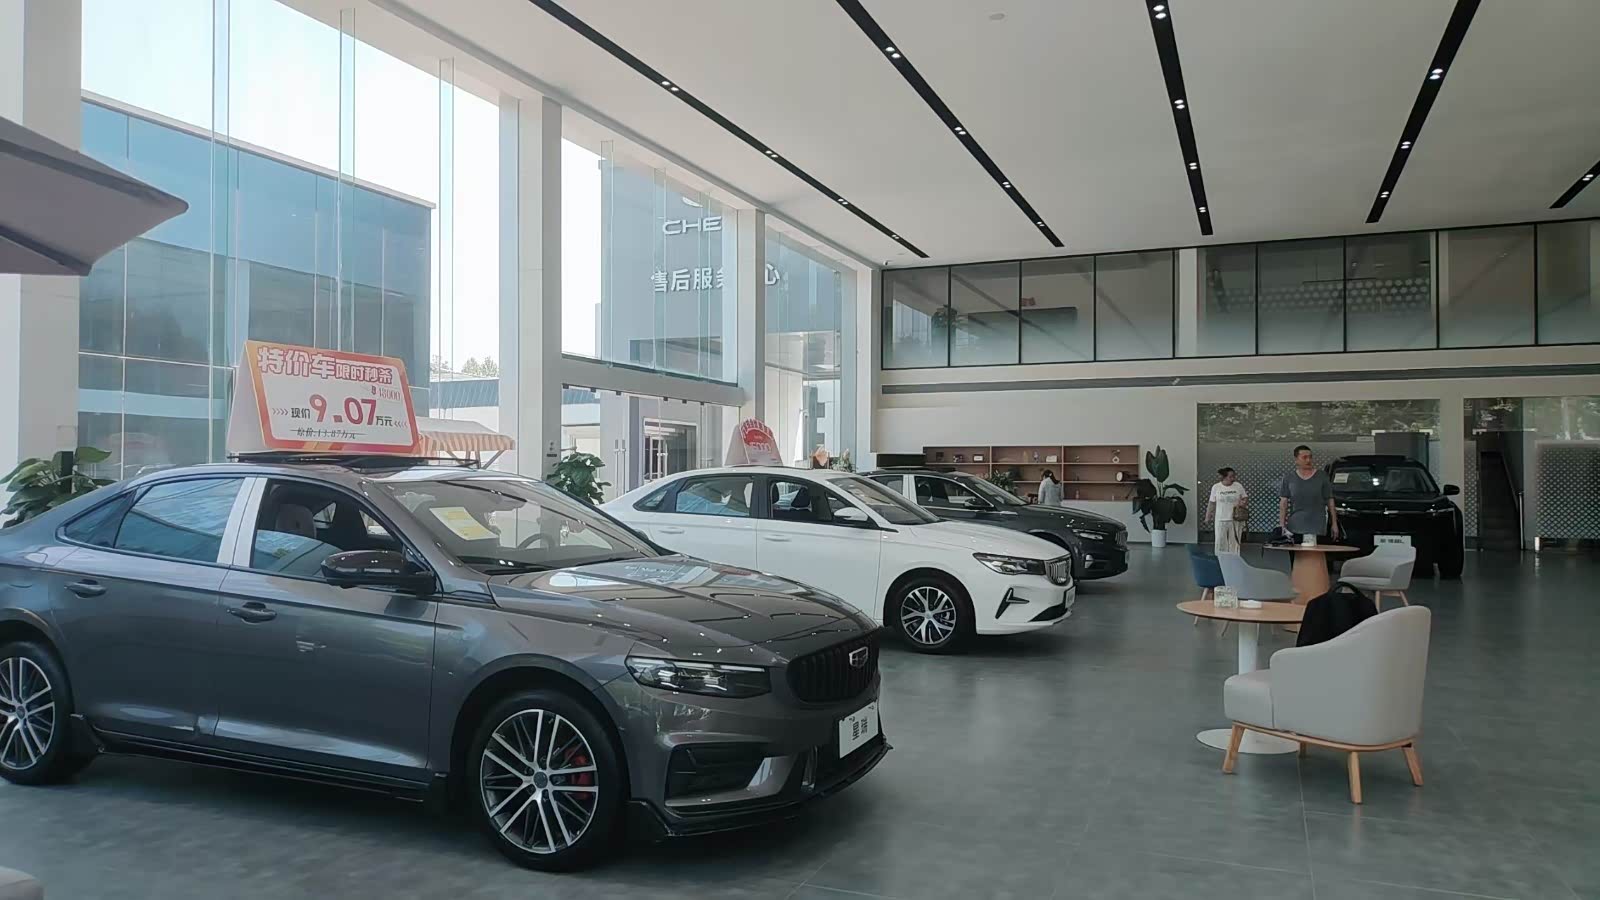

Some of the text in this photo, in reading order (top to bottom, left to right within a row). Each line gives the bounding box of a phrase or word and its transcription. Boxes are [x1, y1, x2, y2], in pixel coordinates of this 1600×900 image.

[257, 347, 393, 384] 特价车限时秒杀
